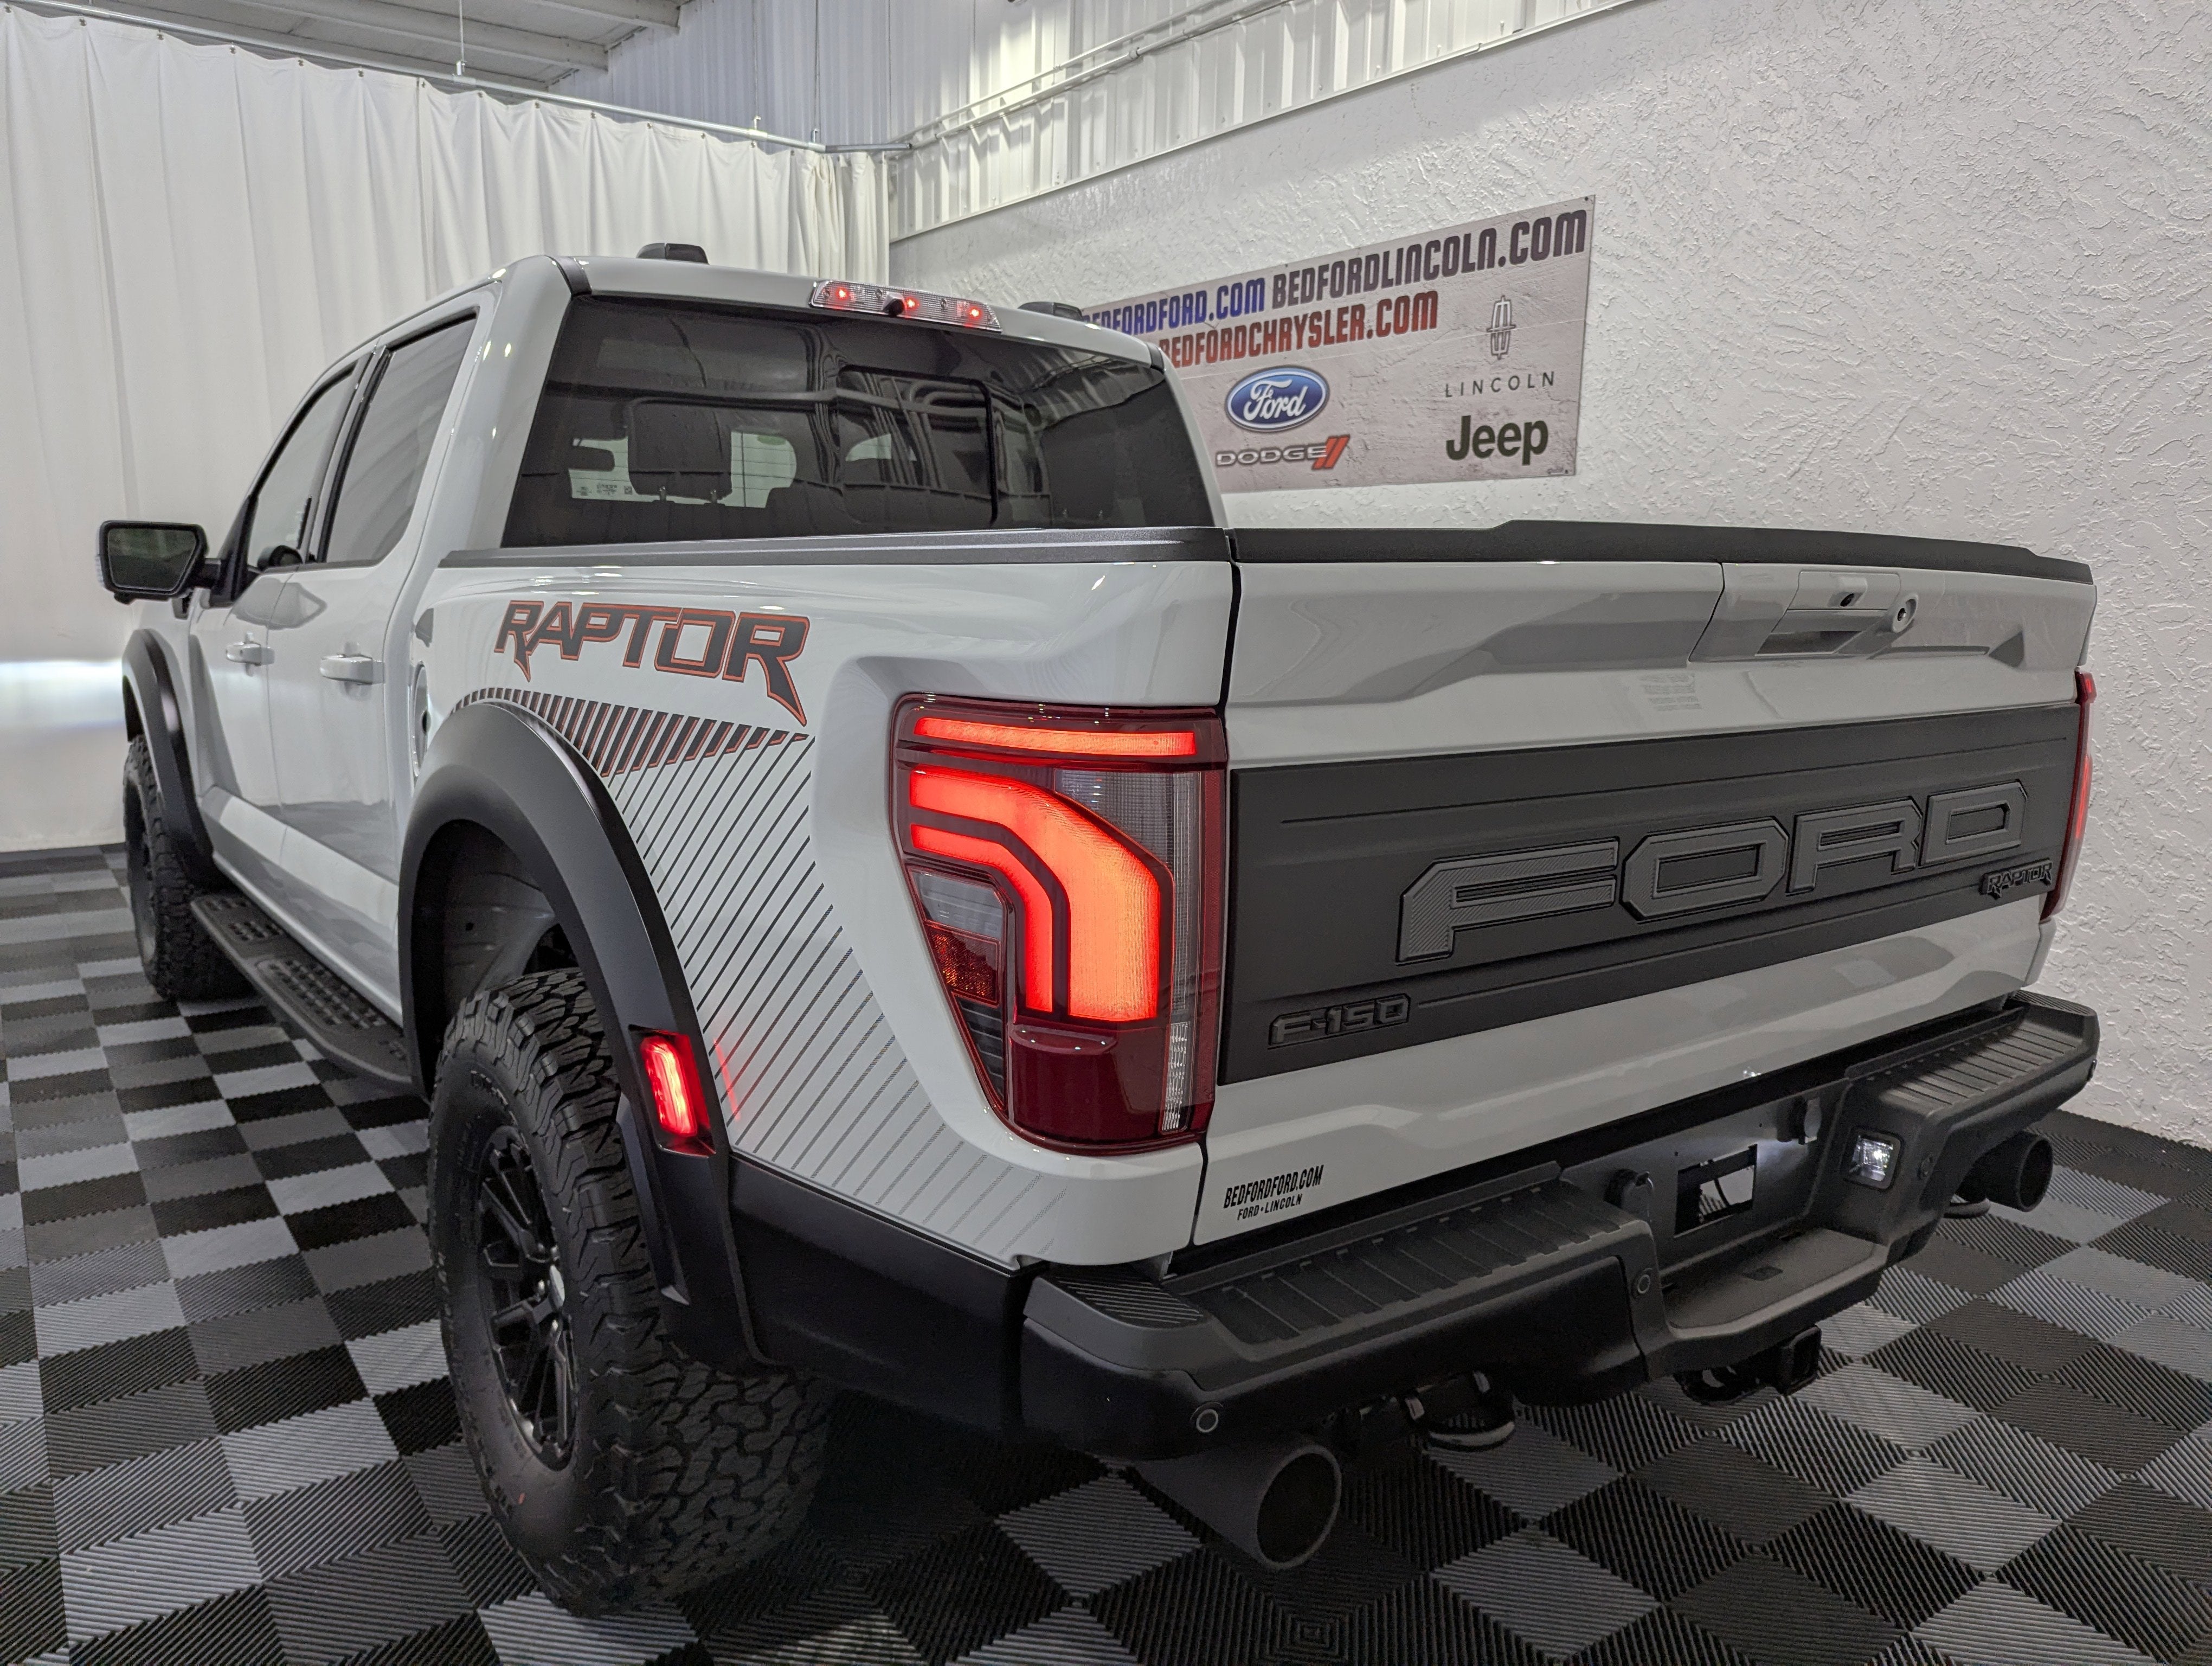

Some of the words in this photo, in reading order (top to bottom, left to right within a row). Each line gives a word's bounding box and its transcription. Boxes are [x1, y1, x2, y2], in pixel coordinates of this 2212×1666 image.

[1083, 277, 1265, 336] DFORDFORD.COM
[1272, 209, 1586, 309] BEDFORDLINCOLN.COM
[1243, 379, 1308, 421] Ford
[1445, 371, 1554, 398] LINCOLN
[1217, 444, 1328, 466] DODGE
[1446, 415, 1548, 466] Jeep
[494, 600, 810, 726] RAPTOR
[1396, 779, 2028, 965] FORD
[1982, 858, 2053, 899] RAPTOR
[1269, 994, 1410, 1047] F-150
[1223, 1164, 1324, 1208] BEDFORDFORD.COM
